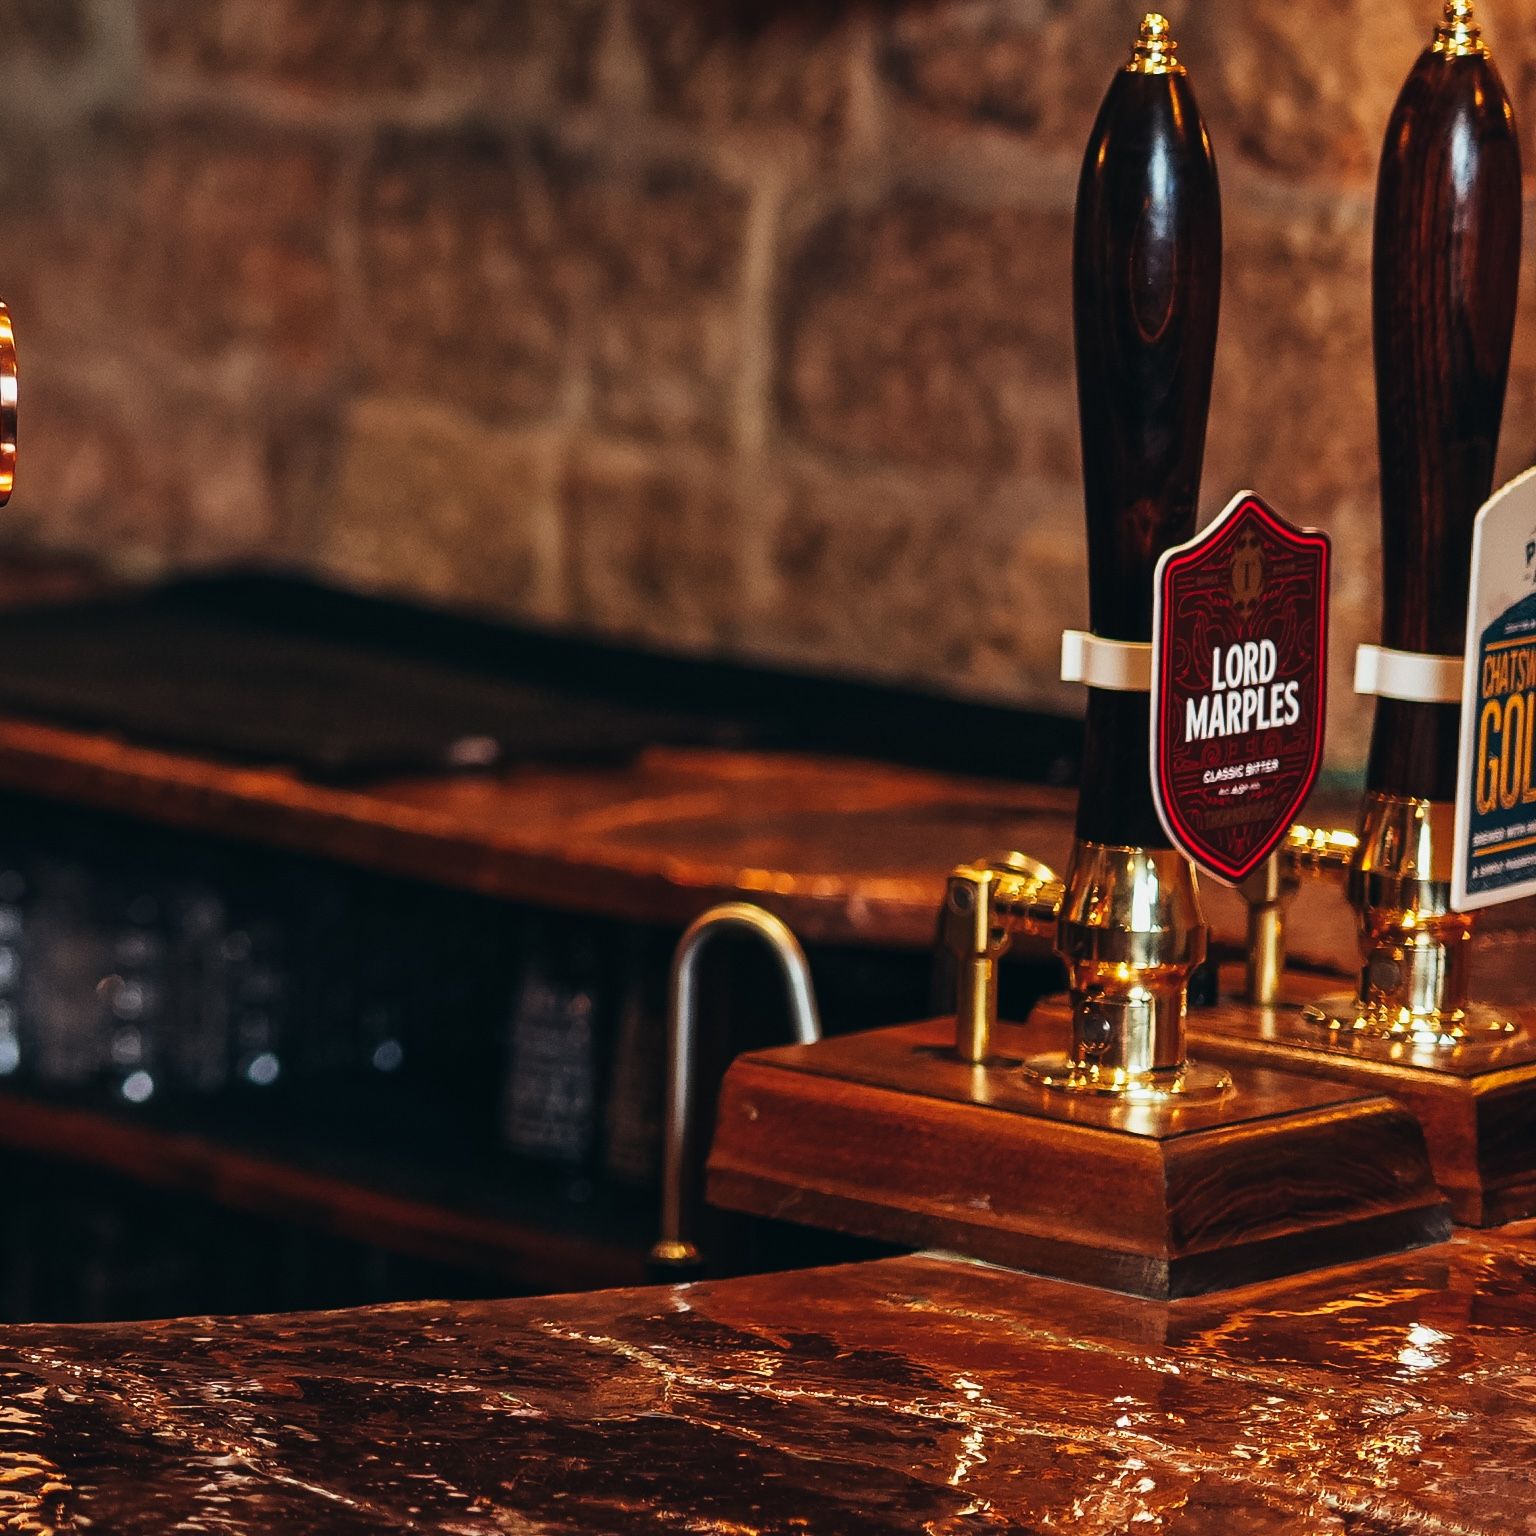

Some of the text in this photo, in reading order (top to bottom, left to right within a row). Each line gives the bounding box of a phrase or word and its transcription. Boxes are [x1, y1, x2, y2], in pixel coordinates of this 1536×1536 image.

[1211, 638, 1277, 692] LORD
[1184, 680, 1300, 743] MARPLES
[1202, 758, 1279, 783] CLASSIC BITTER
